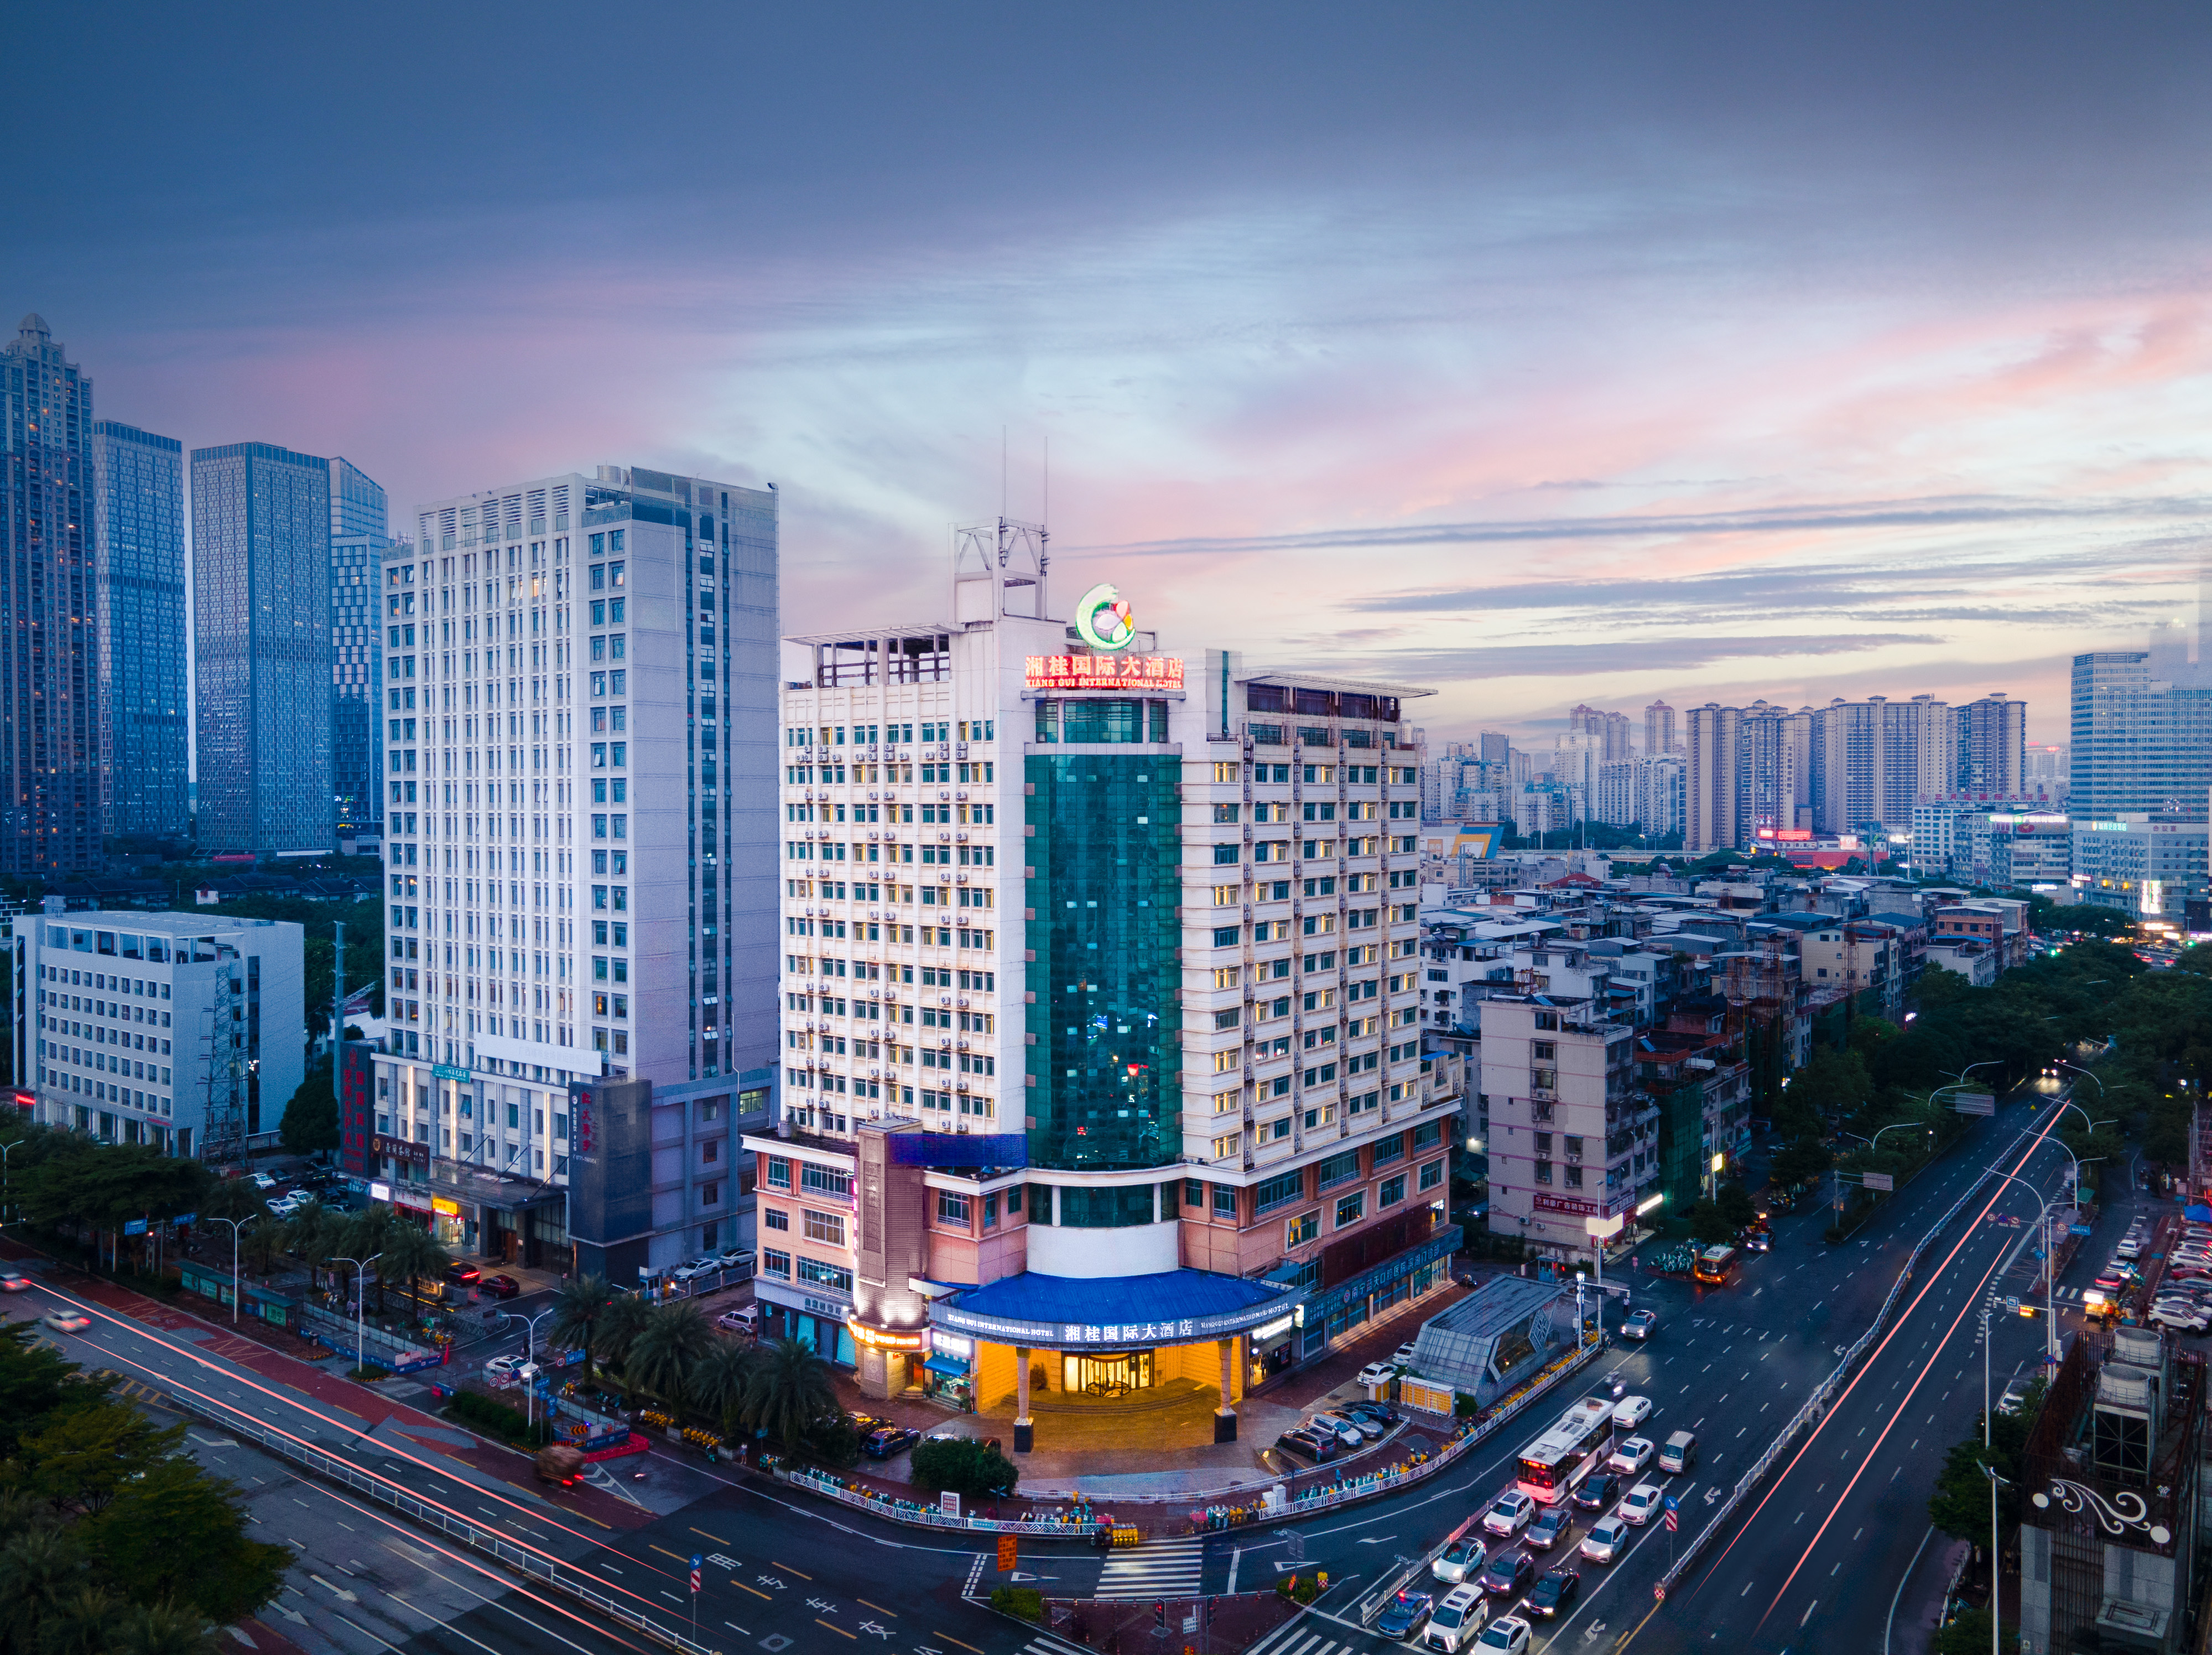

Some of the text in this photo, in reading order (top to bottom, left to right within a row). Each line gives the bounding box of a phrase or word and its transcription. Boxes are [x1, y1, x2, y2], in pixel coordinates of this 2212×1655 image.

[1026, 656, 1184, 678] 湘桂国际大酒店
[1026, 678, 1055, 688] XIANG
[1058, 678, 1076, 686] GUI
[1079, 678, 1155, 687] INTERNATIONAL
[1351, 1245, 1439, 1299] 南宁蓝天口腔医院滨湖门诊部
[1268, 1302, 1289, 1315] HOTEL
[977, 1320, 1030, 1335] INTERNATIONAL
[1031, 1329, 1054, 1337] HOTEL
[1064, 1319, 1193, 1342] 湘桂国际大酒店
